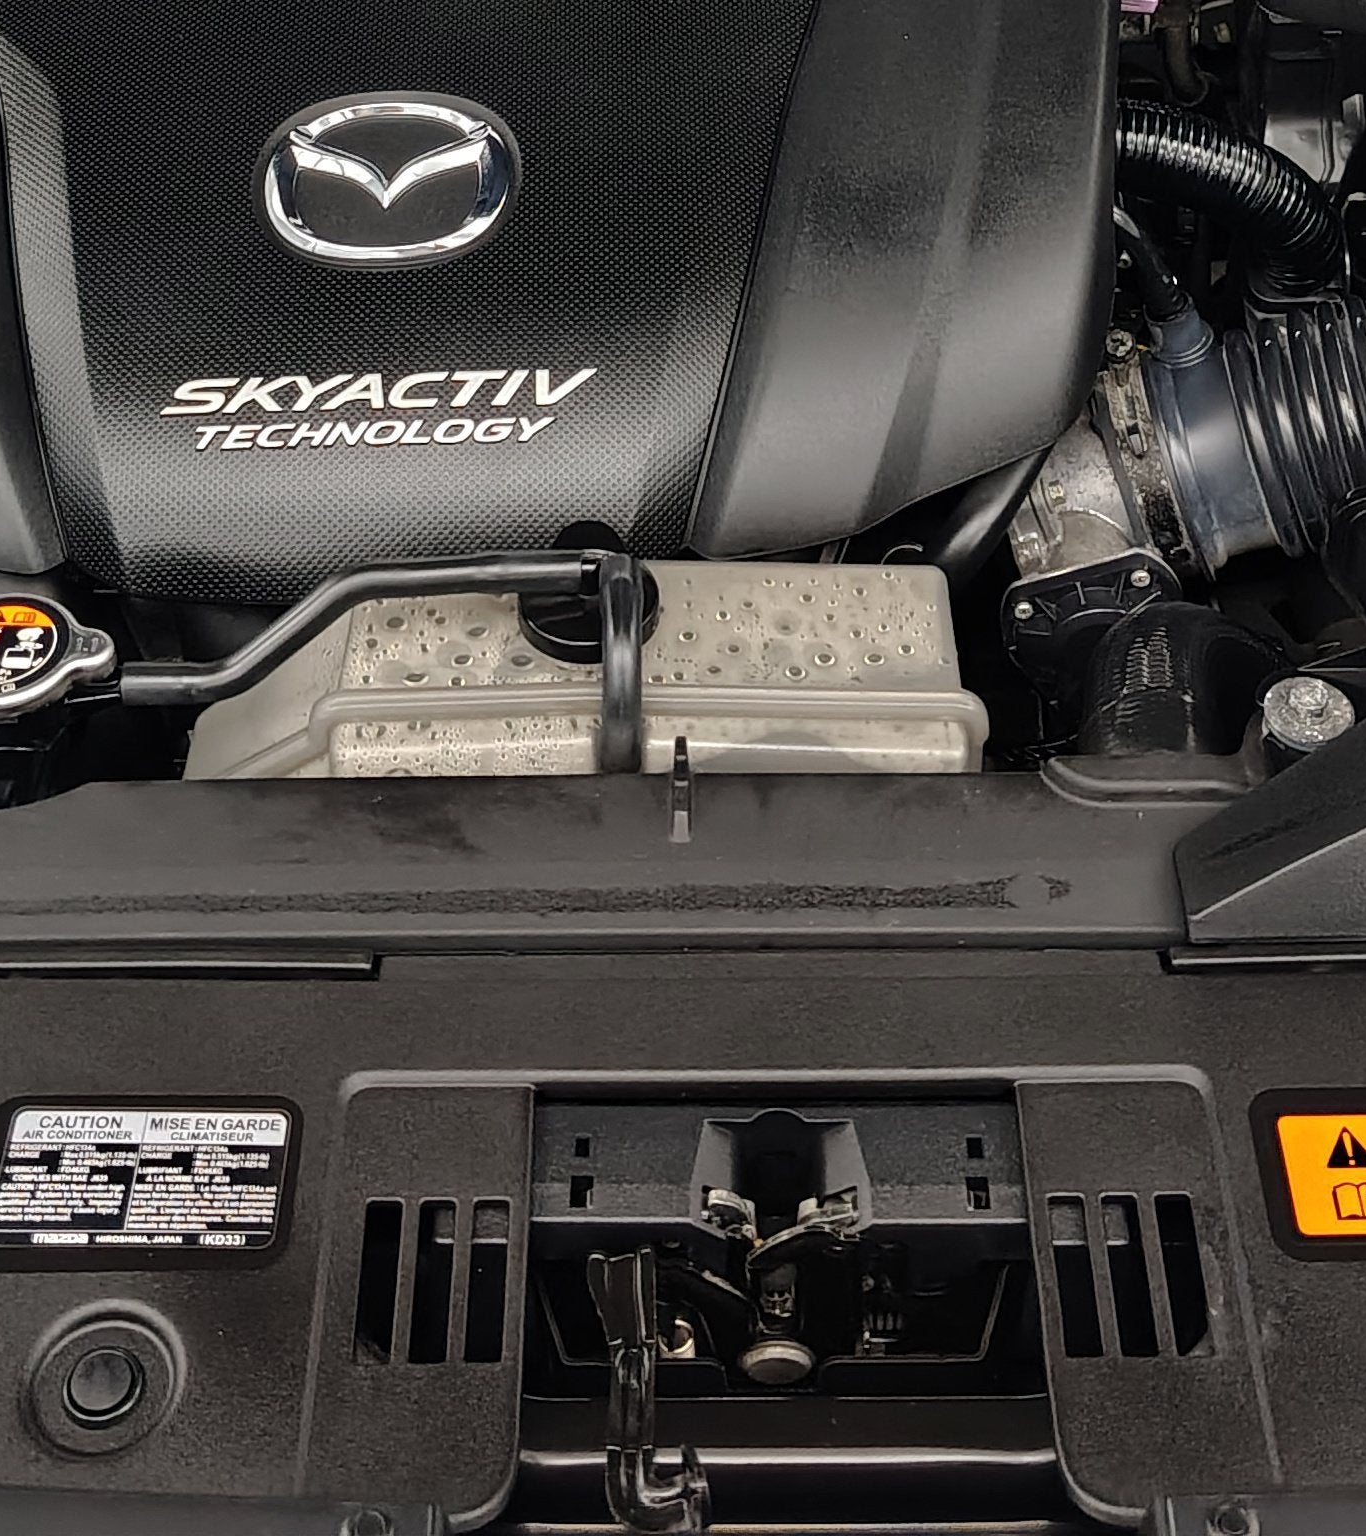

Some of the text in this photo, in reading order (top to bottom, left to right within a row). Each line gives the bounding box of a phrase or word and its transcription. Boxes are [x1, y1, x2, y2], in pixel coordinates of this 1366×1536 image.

[159, 367, 598, 415] SKYACTIV
[194, 417, 556, 450] TECHNOLOGY
[39, 1115, 123, 1129] CAUTION
[150, 1117, 281, 1131] MISE EN GARDE
[22, 1129, 133, 1140] AIR CONDITIONER
[170, 1131, 254, 1142] CLIMATISEUR
[95, 1235, 151, 1245] HIROSHIMA,
[152, 1235, 183, 1244] JAPAN
[198, 1234, 246, 1246] (KD33)
